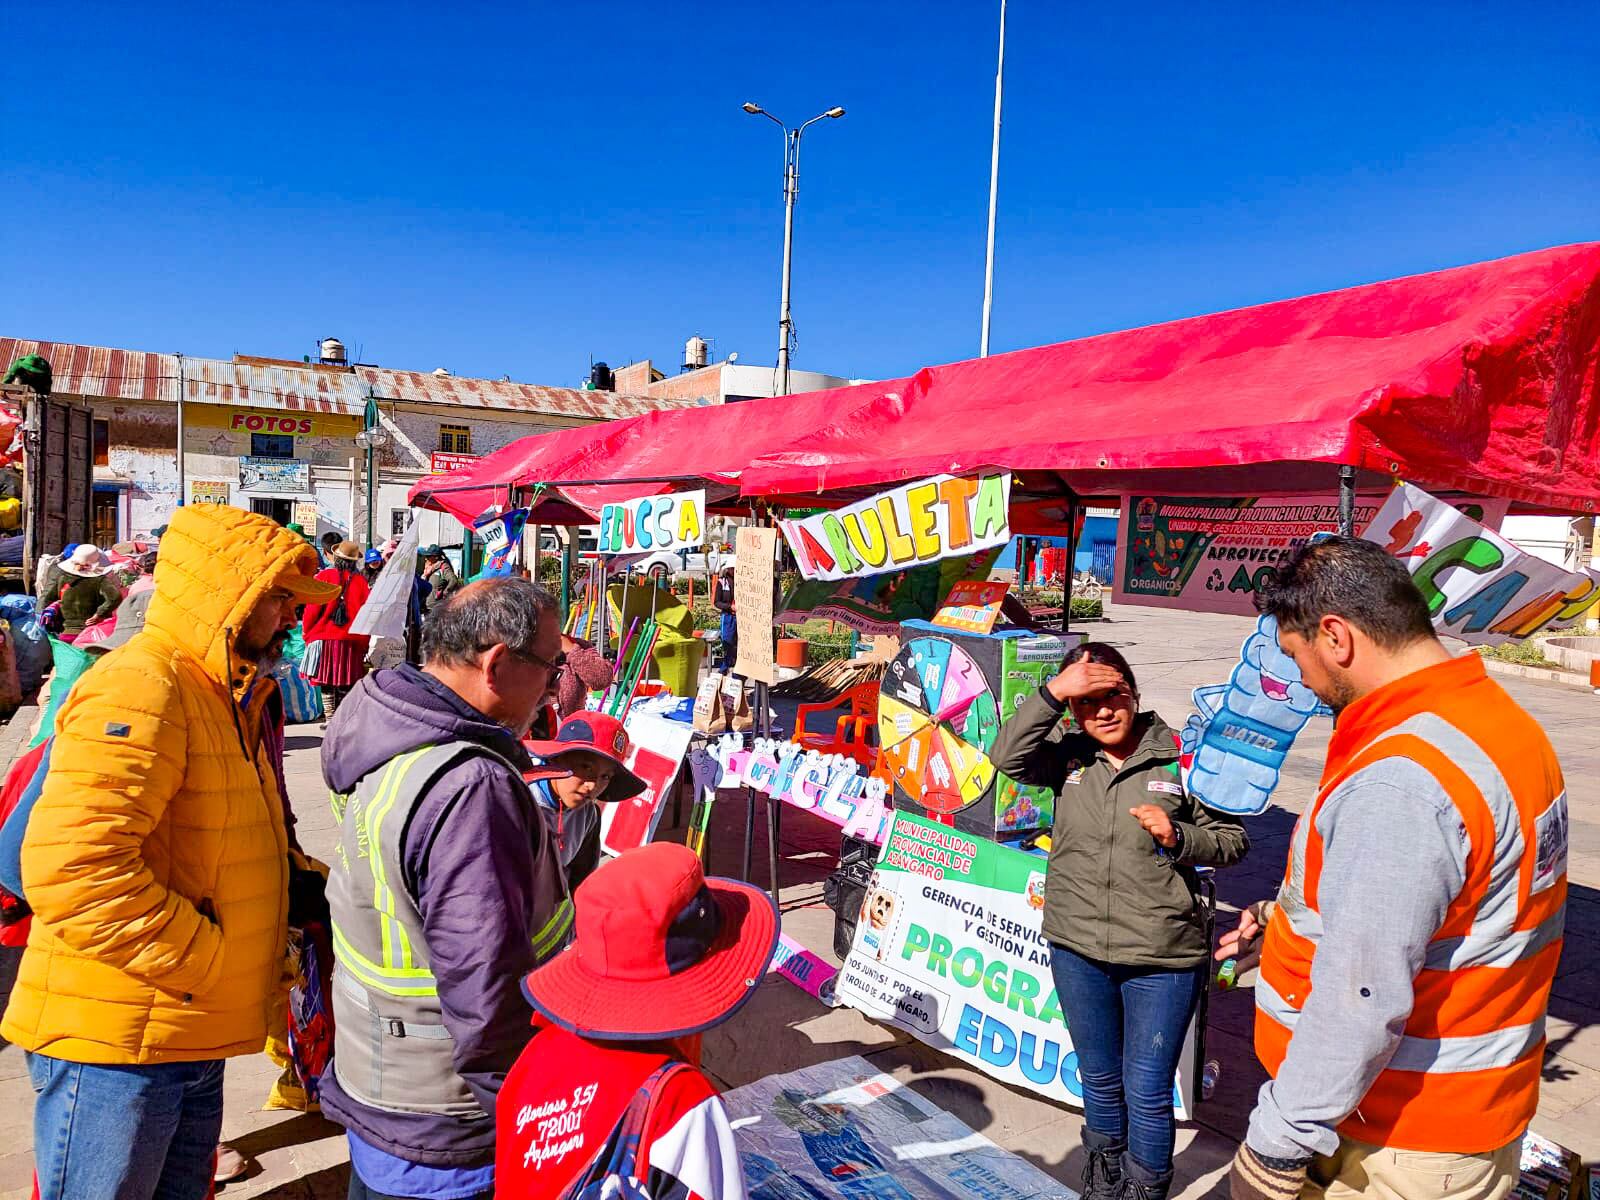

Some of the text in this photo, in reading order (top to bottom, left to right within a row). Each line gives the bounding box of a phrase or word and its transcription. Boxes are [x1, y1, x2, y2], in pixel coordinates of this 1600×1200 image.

[231, 414, 312, 433] FOTOS
[599, 496, 700, 552] EDUCCA
[821, 473, 1008, 574] RULETA
[1160, 504, 1377, 523] MUNICIPALIDAD PROVINCIAL DE AZAGAR
[1168, 521, 1197, 532] UNIDAD
[1199, 523, 1211, 532] DE
[1252, 524, 1265, 535] DE
[1265, 524, 1313, 535] RESIDUOS
[1214, 535, 1264, 546] DEPOSITA
[1267, 537, 1286, 546] TUS
[928, 641, 936, 658] 1
[892, 661, 906, 680] 8
[960, 660, 972, 680] 2
[1221, 723, 1278, 752] WATER
[972, 774, 983, 792] 4
[895, 818, 977, 858] MUNICIPALIDAD
[891, 835, 972, 875] PROVINCIAL DE
[922, 886, 983, 919] GERENCIA
[987, 910, 998, 927] DE
[964, 919, 973, 932] Y
[976, 925, 1025, 958] GESTIÓN
[901, 922, 1069, 1030] PROGRA
[893, 980, 912, 996] POR
[912, 989, 923, 1002] EL
[516, 1104, 568, 1134] Glorioso
[537, 1108, 582, 1142] 72001
